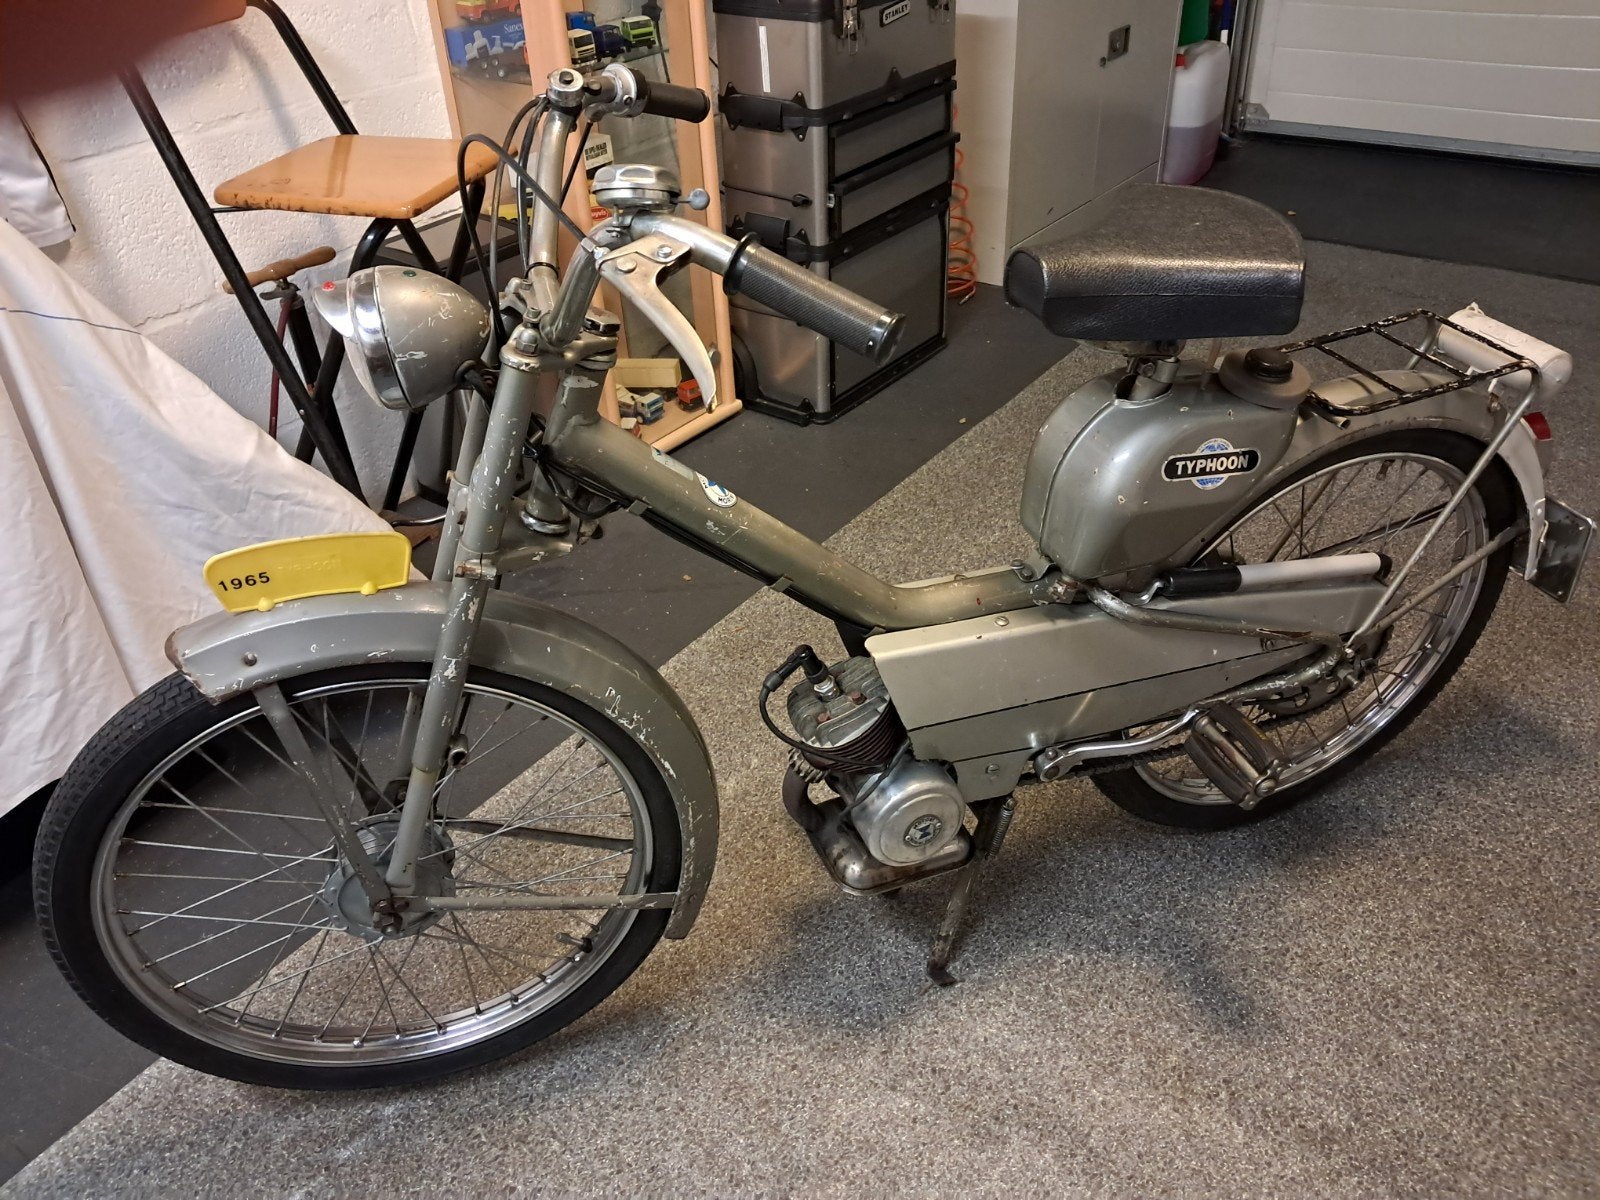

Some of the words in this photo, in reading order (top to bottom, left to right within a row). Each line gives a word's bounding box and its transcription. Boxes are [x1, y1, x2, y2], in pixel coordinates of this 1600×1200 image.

[884, 4, 908, 21] STANLEY
[1175, 454, 1249, 476] TYPHOON
[218, 571, 270, 592] 1965
